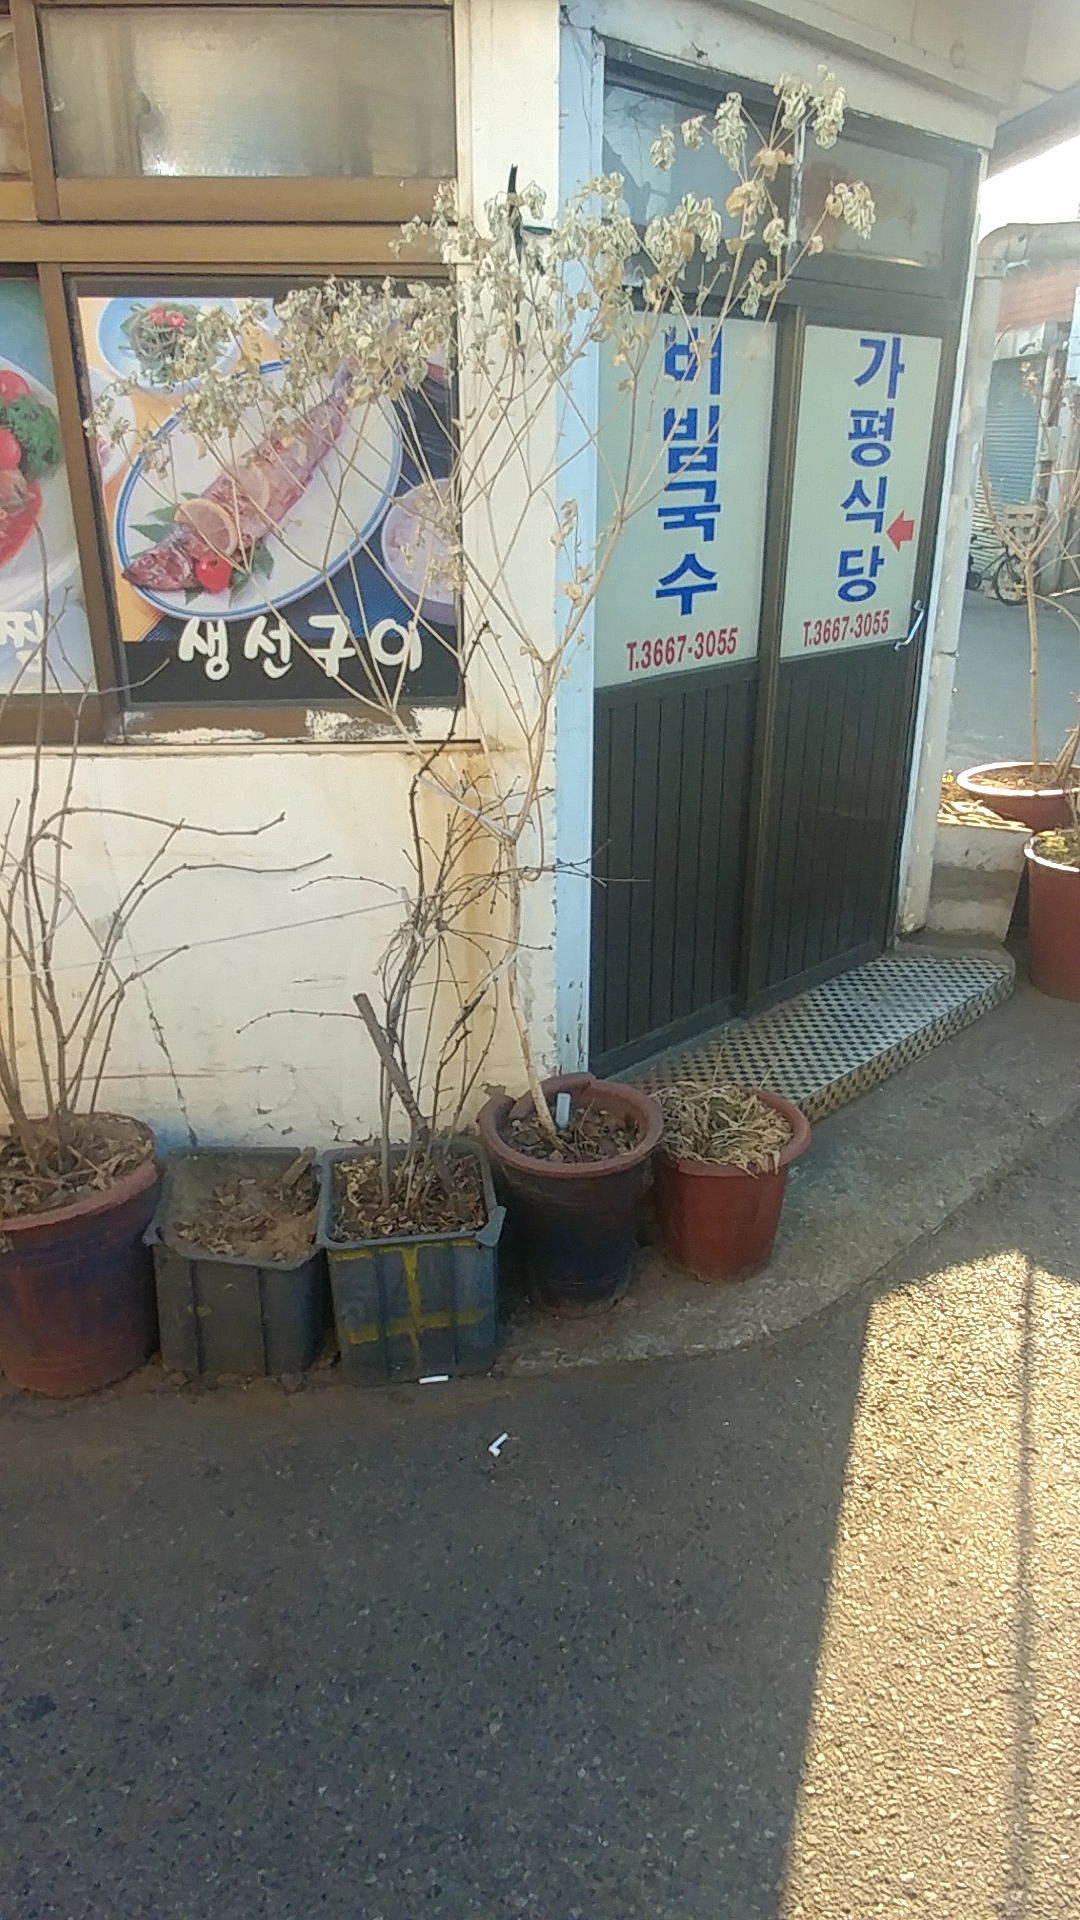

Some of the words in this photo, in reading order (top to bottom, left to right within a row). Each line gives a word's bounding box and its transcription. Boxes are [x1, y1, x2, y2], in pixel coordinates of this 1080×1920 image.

[655, 324, 724, 617] 비빔국수
[837, 336, 906, 604] 가평식당
[178, 614, 424, 682] 생선구이
[626, 627, 739, 672] T.3667-3055
[802, 609, 890, 647] T.3667-3055
